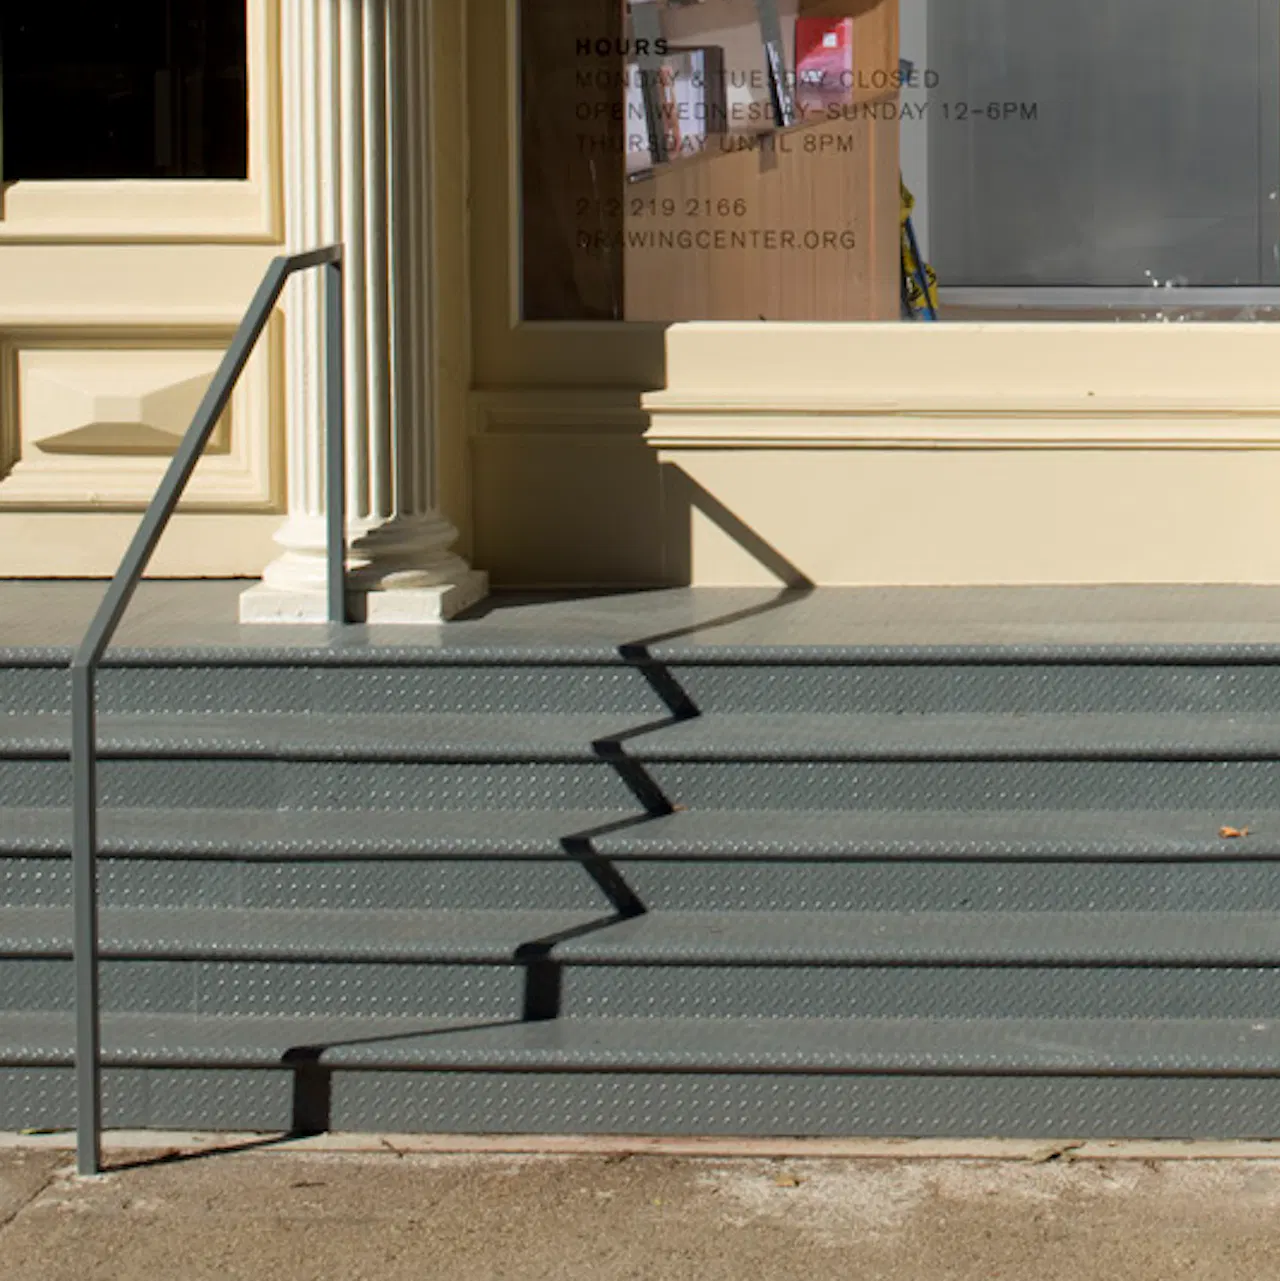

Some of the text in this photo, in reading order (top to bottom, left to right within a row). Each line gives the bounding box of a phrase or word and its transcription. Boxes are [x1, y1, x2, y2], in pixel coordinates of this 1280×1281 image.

[576, 37, 669, 57] HOURS
[576, 69, 680, 89] MONDAY
[839, 69, 940, 89] CLOSED
[576, 101, 643, 121] OPEN
[576, 132, 854, 153] THURSDAY UNTIL 8PM
[575, 197, 748, 217] 22 219 2166
